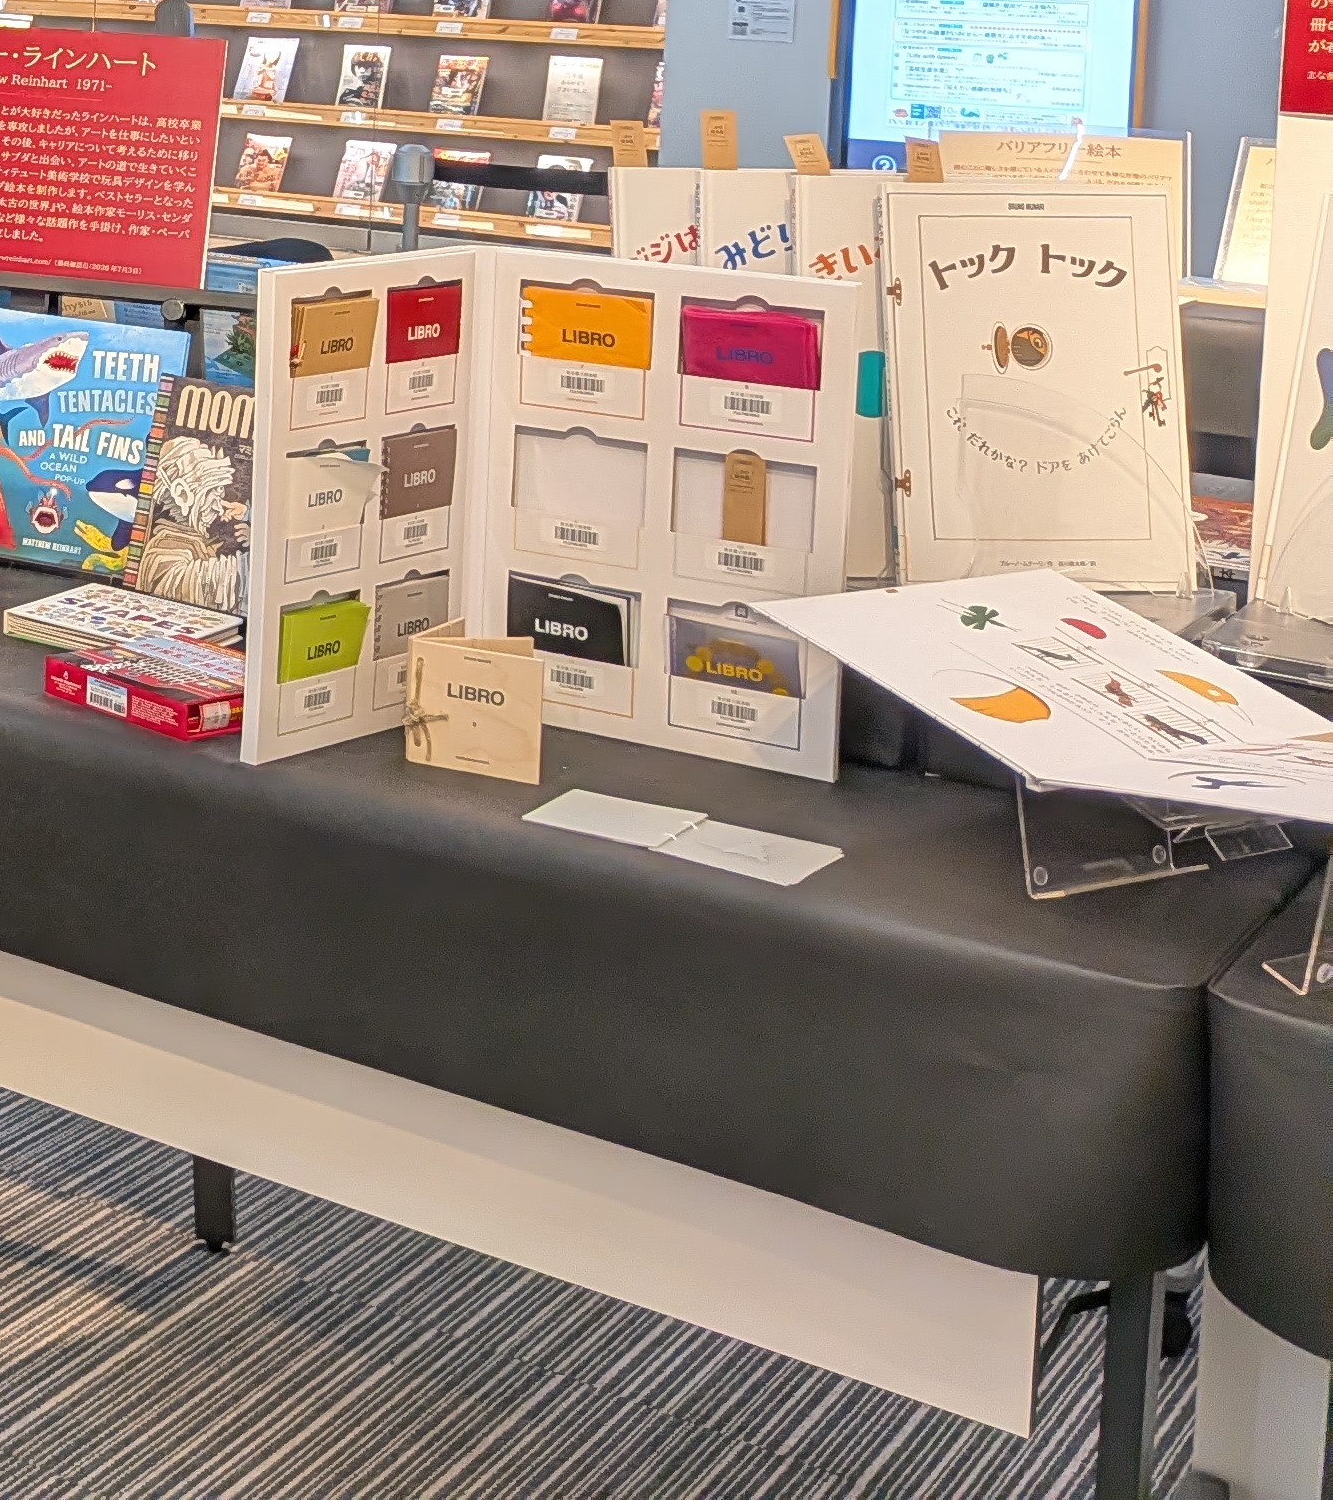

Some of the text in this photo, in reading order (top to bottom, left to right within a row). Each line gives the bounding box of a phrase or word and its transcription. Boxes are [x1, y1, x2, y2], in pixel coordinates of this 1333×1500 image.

[11, 74, 68, 89] Reinhart
[76, 77, 112, 92] 1971-
[808, 244, 881, 280] きい
[928, 243, 1127, 290] トック トック
[407, 323, 440, 340] LIBRO
[561, 329, 616, 348] LIBRO
[320, 338, 354, 354] LIBRO
[716, 346, 773, 365] LIBRO
[92, 350, 160, 383] TEETH
[57, 389, 157, 415] TENTACLES
[18, 423, 144, 465] AND TAIL FINS
[40, 461, 77, 473] OCEAN
[49, 452, 88, 465] A WILD
[54, 473, 86, 485] POP-UP
[403, 468, 436, 488] LIBRO
[308, 488, 342, 508] LIBRO
[397, 617, 430, 637] LIBRO
[534, 617, 589, 641] LIBRO
[307, 639, 341, 660] LIBRO
[705, 661, 763, 683] LIBRO
[447, 682, 505, 707] LIBRO
